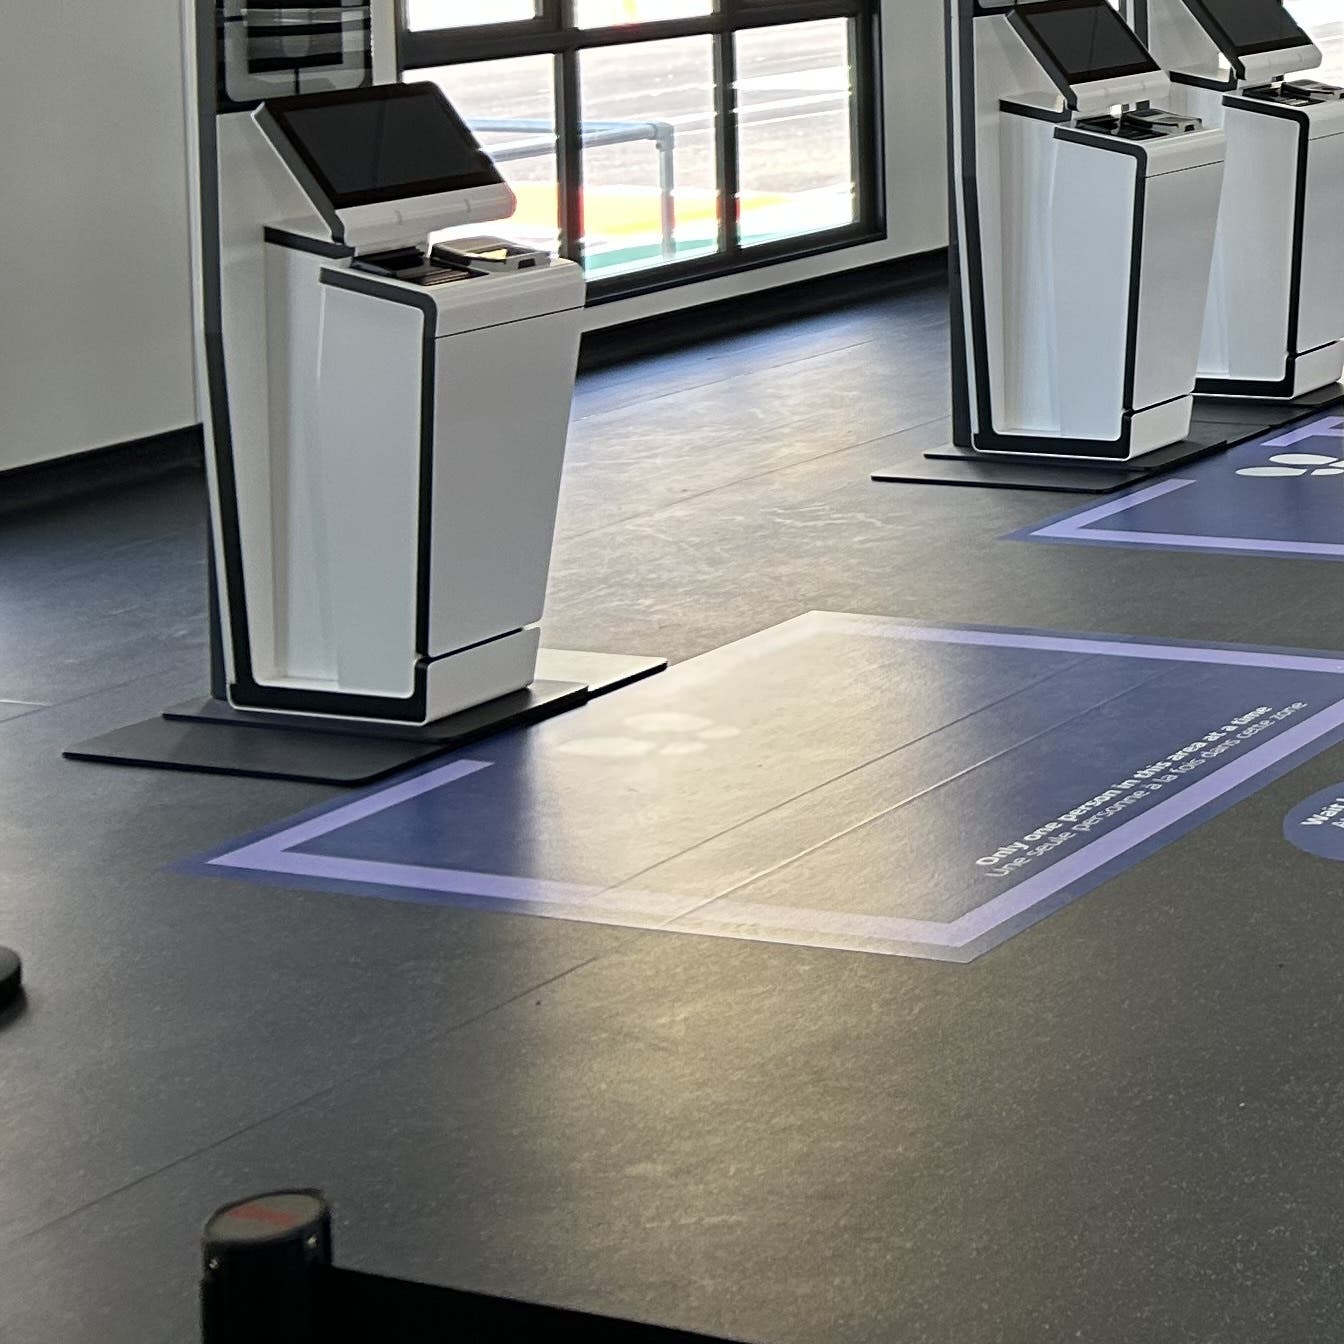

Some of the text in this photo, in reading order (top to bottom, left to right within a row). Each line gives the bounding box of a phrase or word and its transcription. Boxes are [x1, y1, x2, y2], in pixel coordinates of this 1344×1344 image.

[975, 841, 1030, 866] Only
[1023, 822, 1063, 841] one
[1057, 789, 1123, 822] person
[1110, 778, 1141, 789] in
[1133, 761, 1172, 778] this
[1166, 741, 1208, 761] area
[1201, 730, 1228, 742] at
[1230, 705, 1272, 725] time
[984, 856, 1033, 877] Une
[1026, 831, 1077, 856] seule
[1071, 790, 1151, 832] personne
[1151, 773, 1179, 783] la
[1170, 757, 1206, 774] fois
[1200, 738, 1241, 758] dans
[1236, 719, 1276, 739] cette
[1269, 702, 1308, 721] zone
